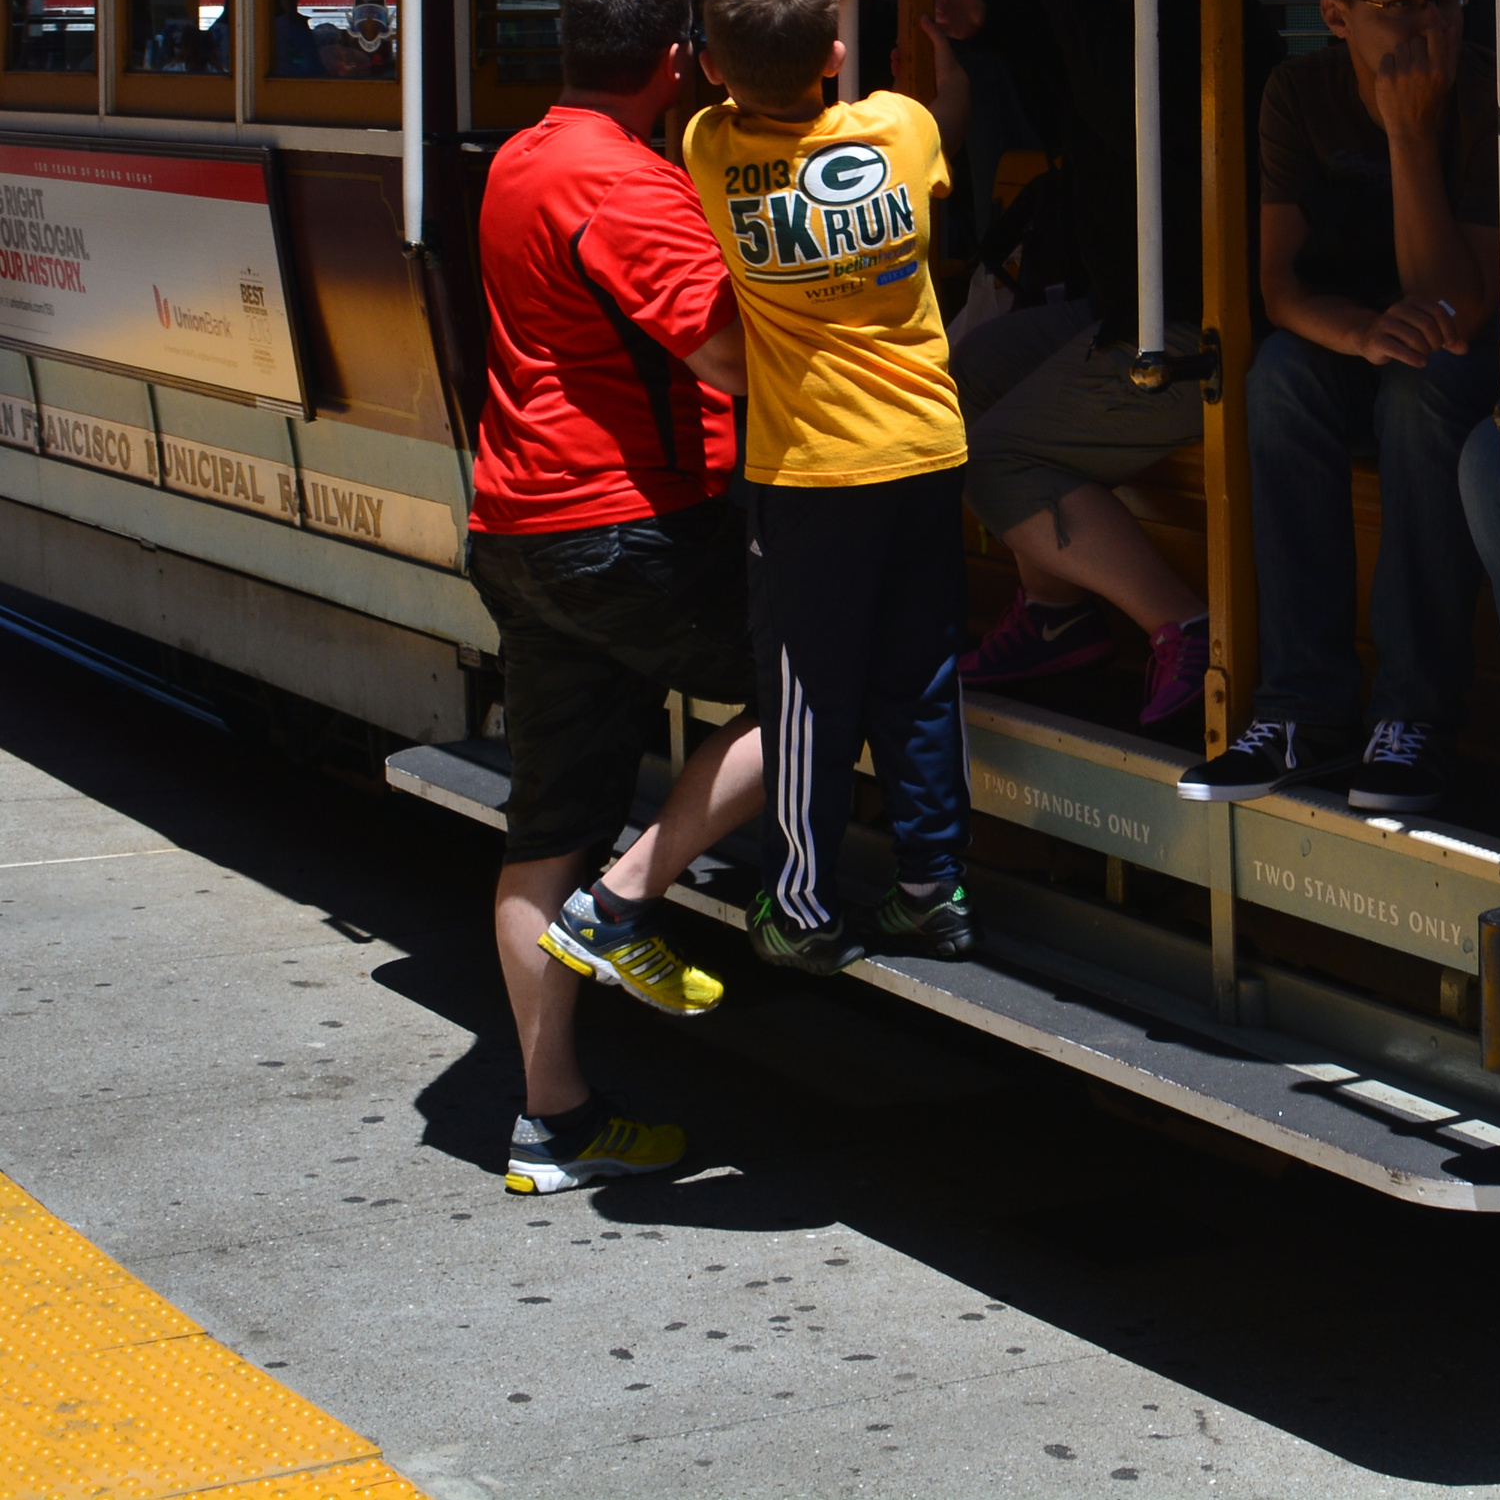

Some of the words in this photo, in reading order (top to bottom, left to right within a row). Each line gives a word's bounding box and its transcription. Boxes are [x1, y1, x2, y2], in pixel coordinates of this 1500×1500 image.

[725, 160, 790, 194] 2013
[4, 185, 45, 220] RIGHT
[28, 221, 91, 261] SLOGAN.
[727, 191, 829, 268] 5K
[820, 184, 916, 259] RUN
[24, 254, 86, 294] HISTORY.
[240, 283, 264, 307] BEST
[173, 305, 233, 339] UnionBank
[983, 773, 1017, 800] TWO
[1024, 786, 1100, 829] STANDEES
[1108, 814, 1150, 845] ONLY
[1254, 860, 1295, 891] TWO
[1304, 876, 1399, 927] STANDEES
[1408, 911, 1461, 946] ONLY
